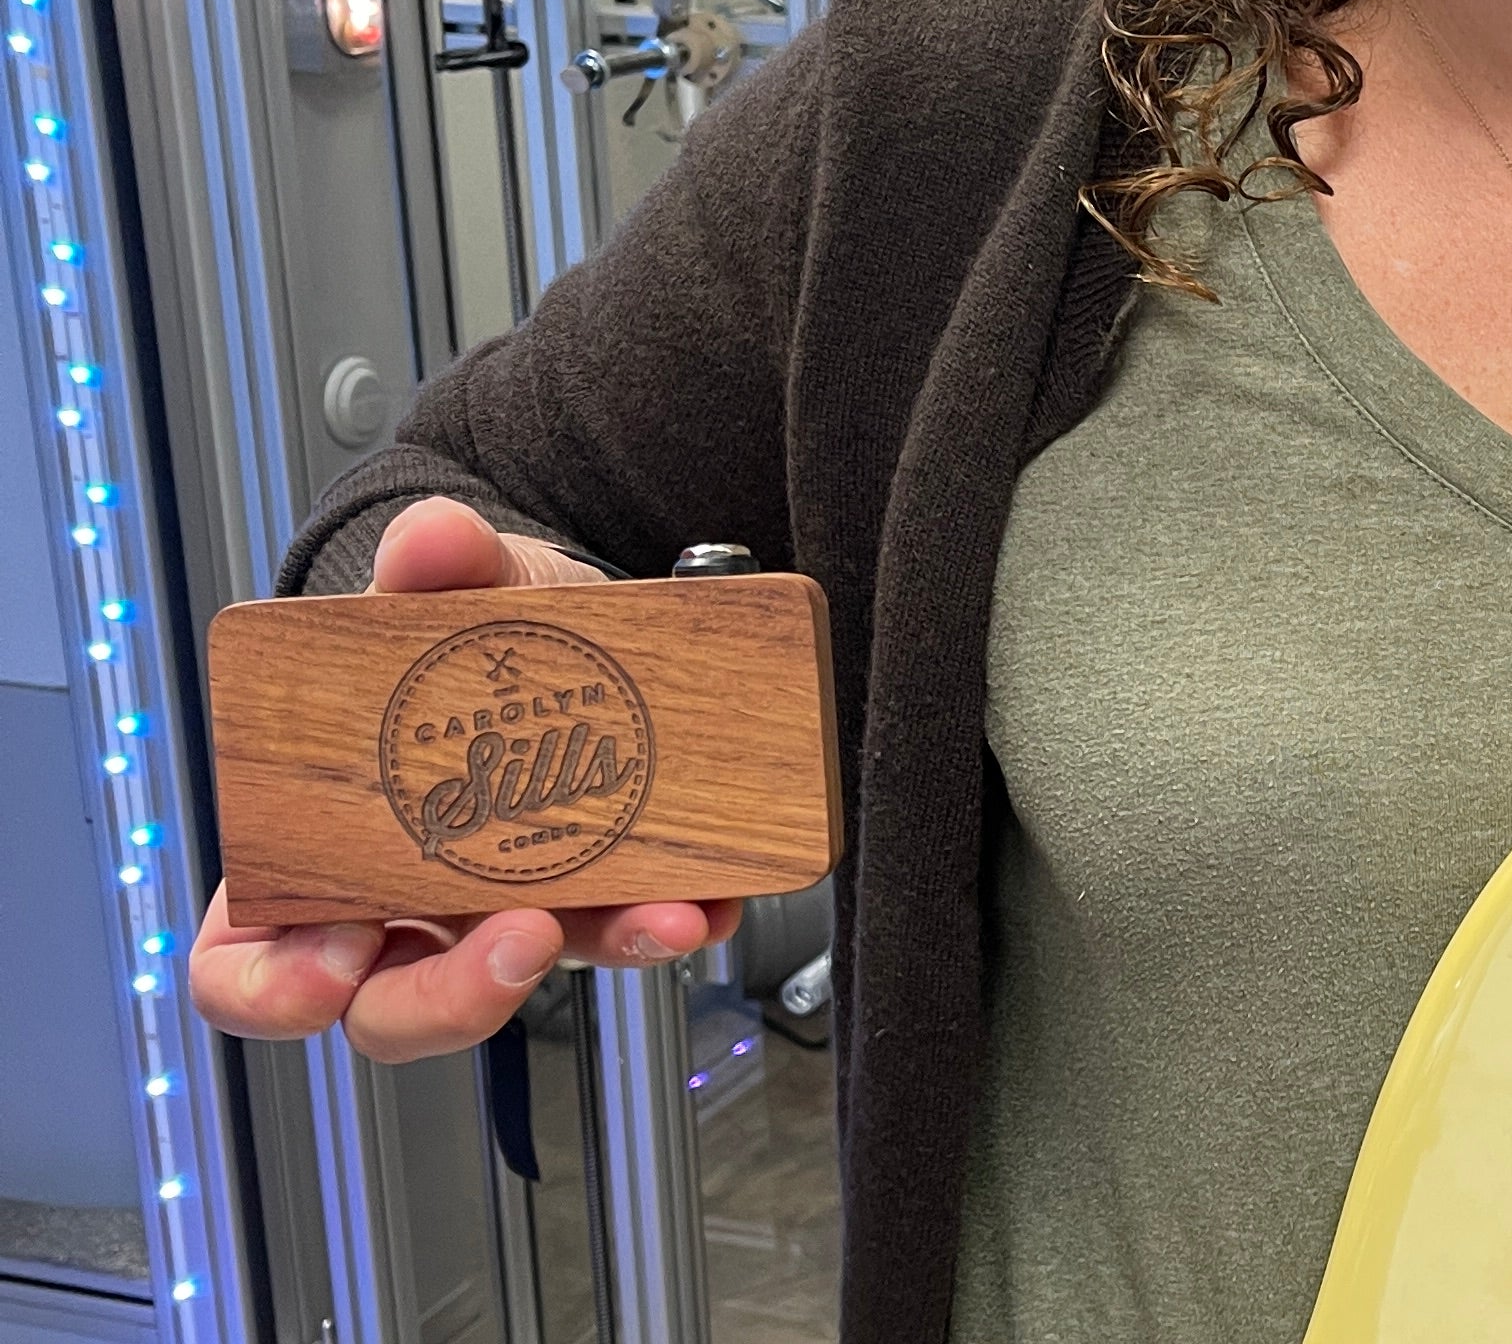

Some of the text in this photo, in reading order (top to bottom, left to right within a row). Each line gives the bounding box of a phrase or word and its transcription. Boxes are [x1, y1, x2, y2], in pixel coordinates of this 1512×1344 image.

[414, 682, 606, 742] CAROLYN
[421, 722, 638, 860] Sills
[497, 823, 582, 853] COMBO
